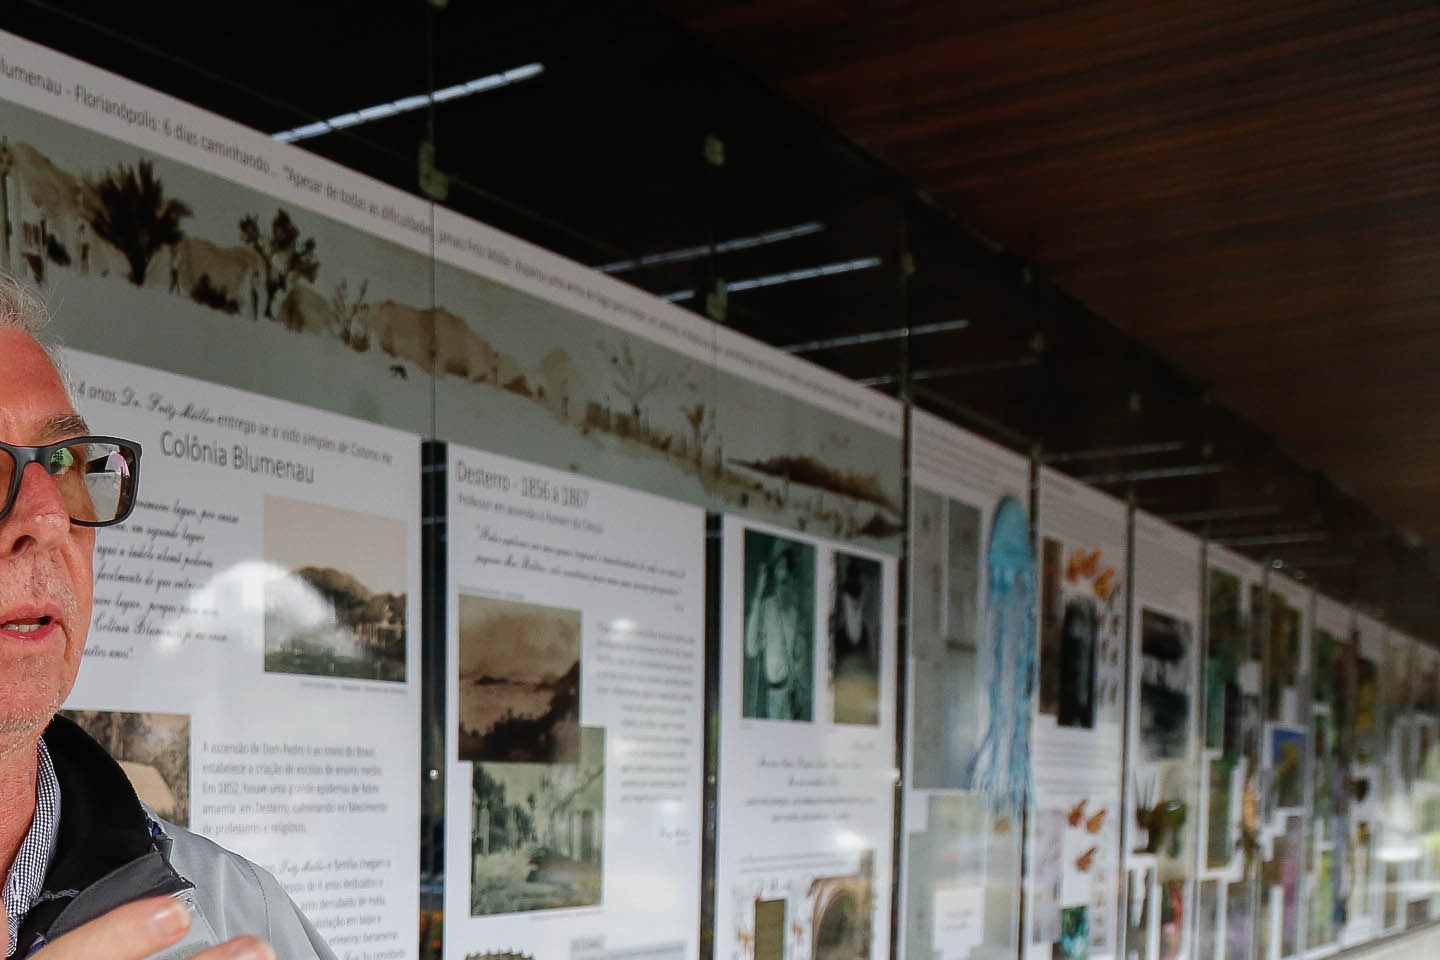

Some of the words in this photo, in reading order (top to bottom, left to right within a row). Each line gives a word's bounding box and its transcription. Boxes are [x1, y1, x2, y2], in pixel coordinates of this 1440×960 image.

[174, 123, 199, 148] dias
[160, 429, 228, 468] Colônia
[232, 443, 315, 485] Blumenau
[455, 460, 511, 494] Desterro
